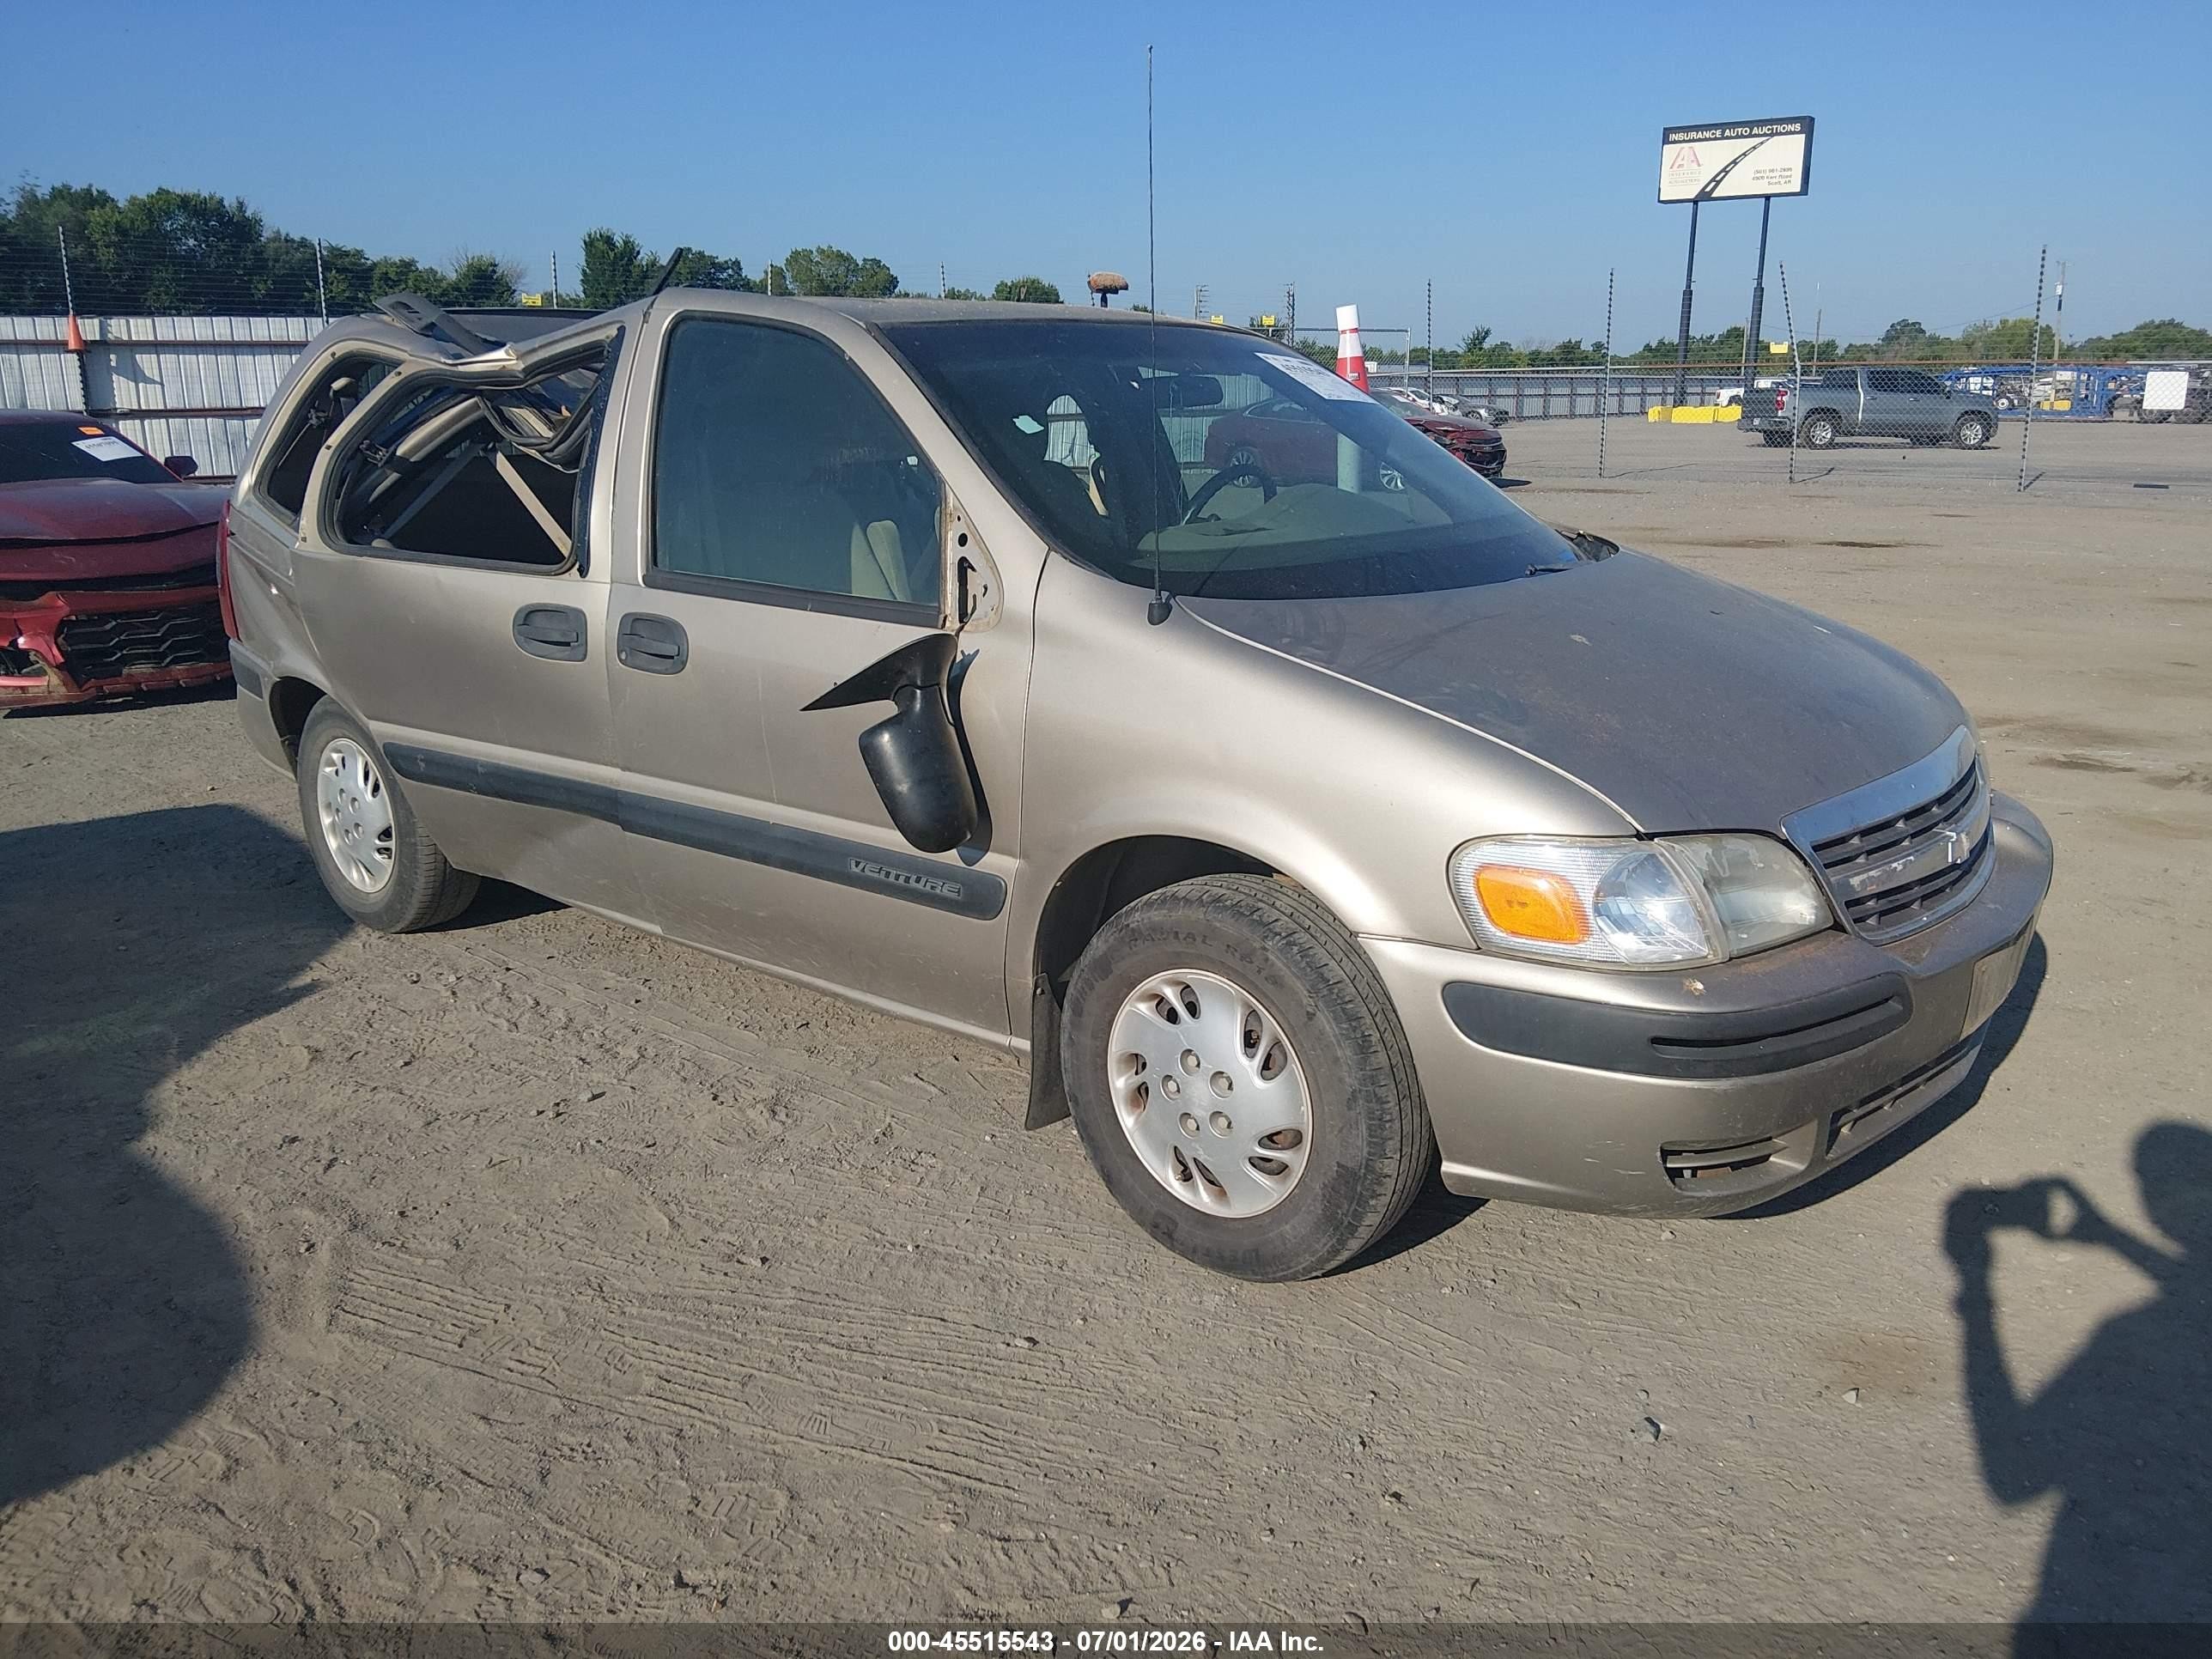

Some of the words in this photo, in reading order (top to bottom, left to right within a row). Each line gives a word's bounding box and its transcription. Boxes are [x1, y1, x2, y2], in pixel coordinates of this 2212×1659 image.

[1668, 130, 1722, 142] INSURANCE
[1723, 127, 1750, 137] AUTO
[1752, 123, 1802, 135] AUCTIONS
